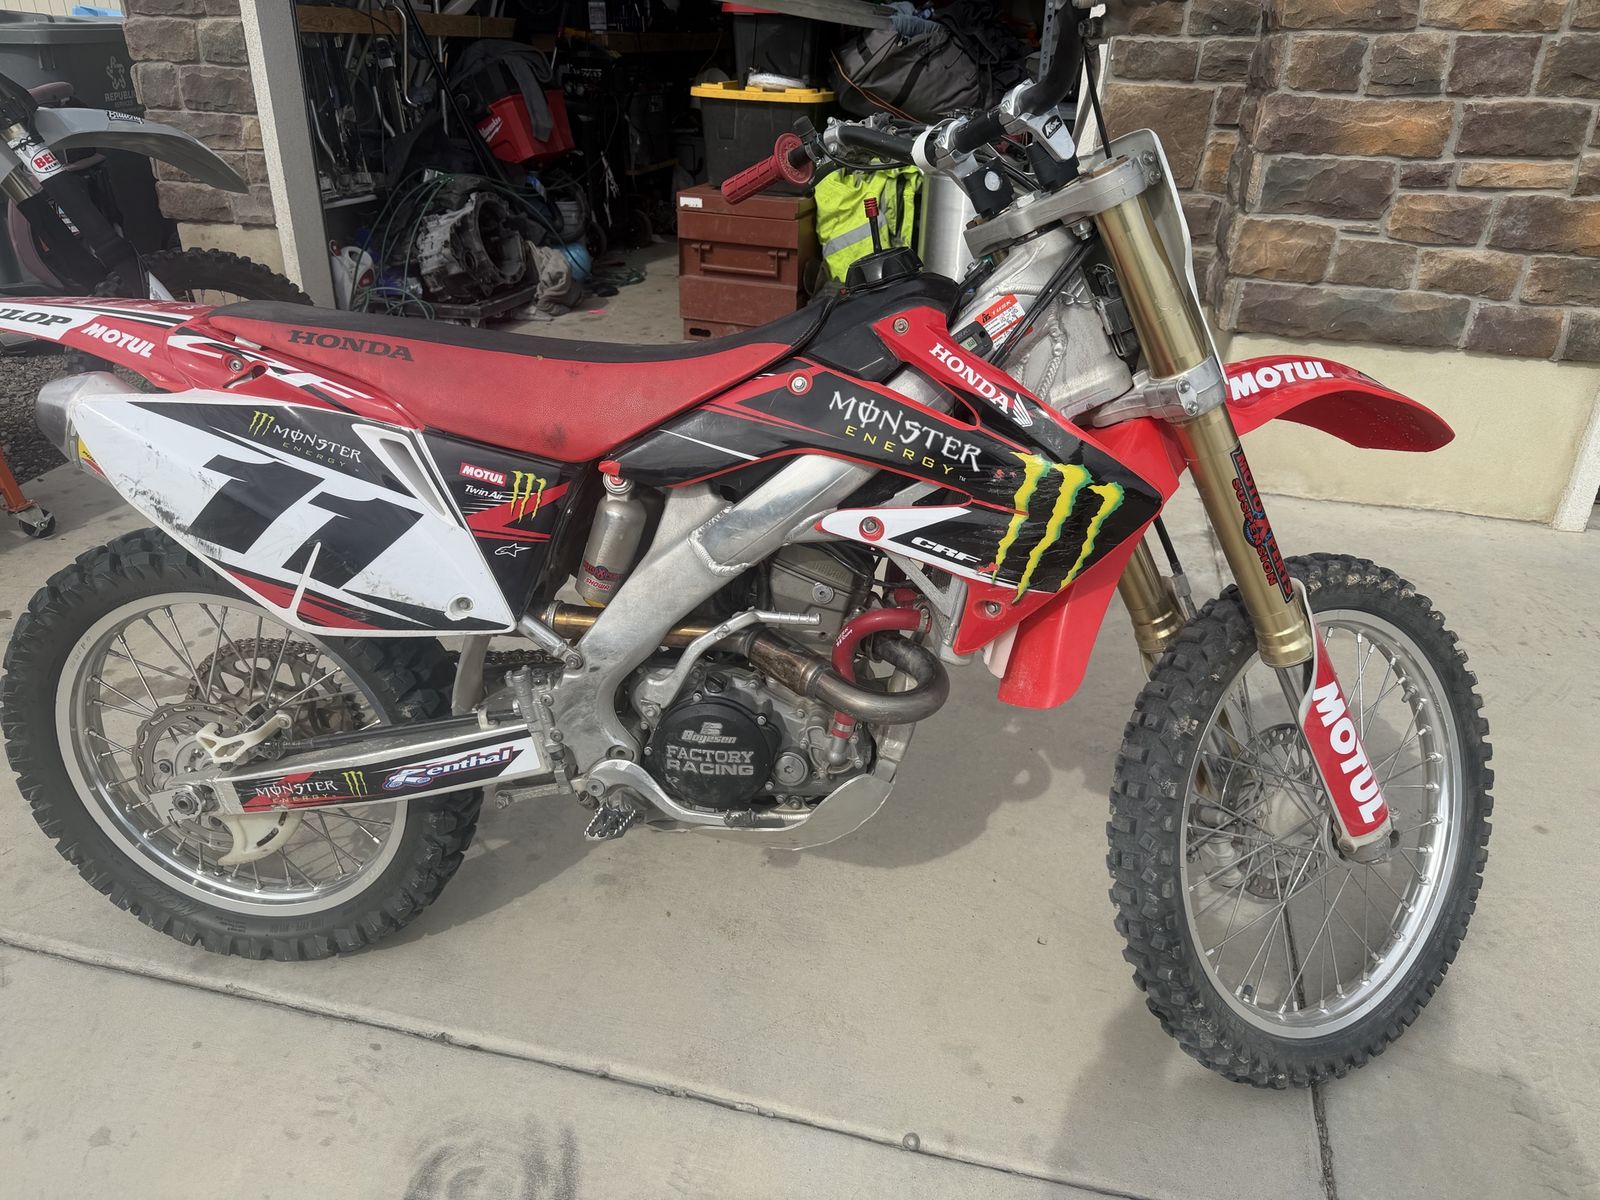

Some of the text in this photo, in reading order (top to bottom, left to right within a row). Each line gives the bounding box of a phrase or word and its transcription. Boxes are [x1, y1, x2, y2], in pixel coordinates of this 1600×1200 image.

[105, 91, 134, 102] REPUBLI
[80, 323, 156, 358] MOTUL
[288, 329, 414, 362] HONDA
[929, 342, 1009, 415] HONDA
[1229, 361, 1334, 400] MOTUL
[273, 424, 362, 463] MONSTER
[828, 391, 982, 472] MONSTER
[282, 441, 346, 467] ENERGY
[844, 425, 954, 475] ENERGY
[462, 465, 504, 485] MOTUL
[464, 484, 504, 500] Twin Air
[1232, 477, 1279, 587] SUSPENSION
[911, 537, 982, 563] CRF
[681, 730, 737, 744] Boyesen
[666, 744, 755, 763] FACTORY
[1312, 680, 1385, 824] MOTUL
[383, 747, 513, 790] Renthal
[666, 758, 755, 776] RACING
[255, 780, 339, 798] MONSTER
[272, 793, 329, 803] ENERGY
